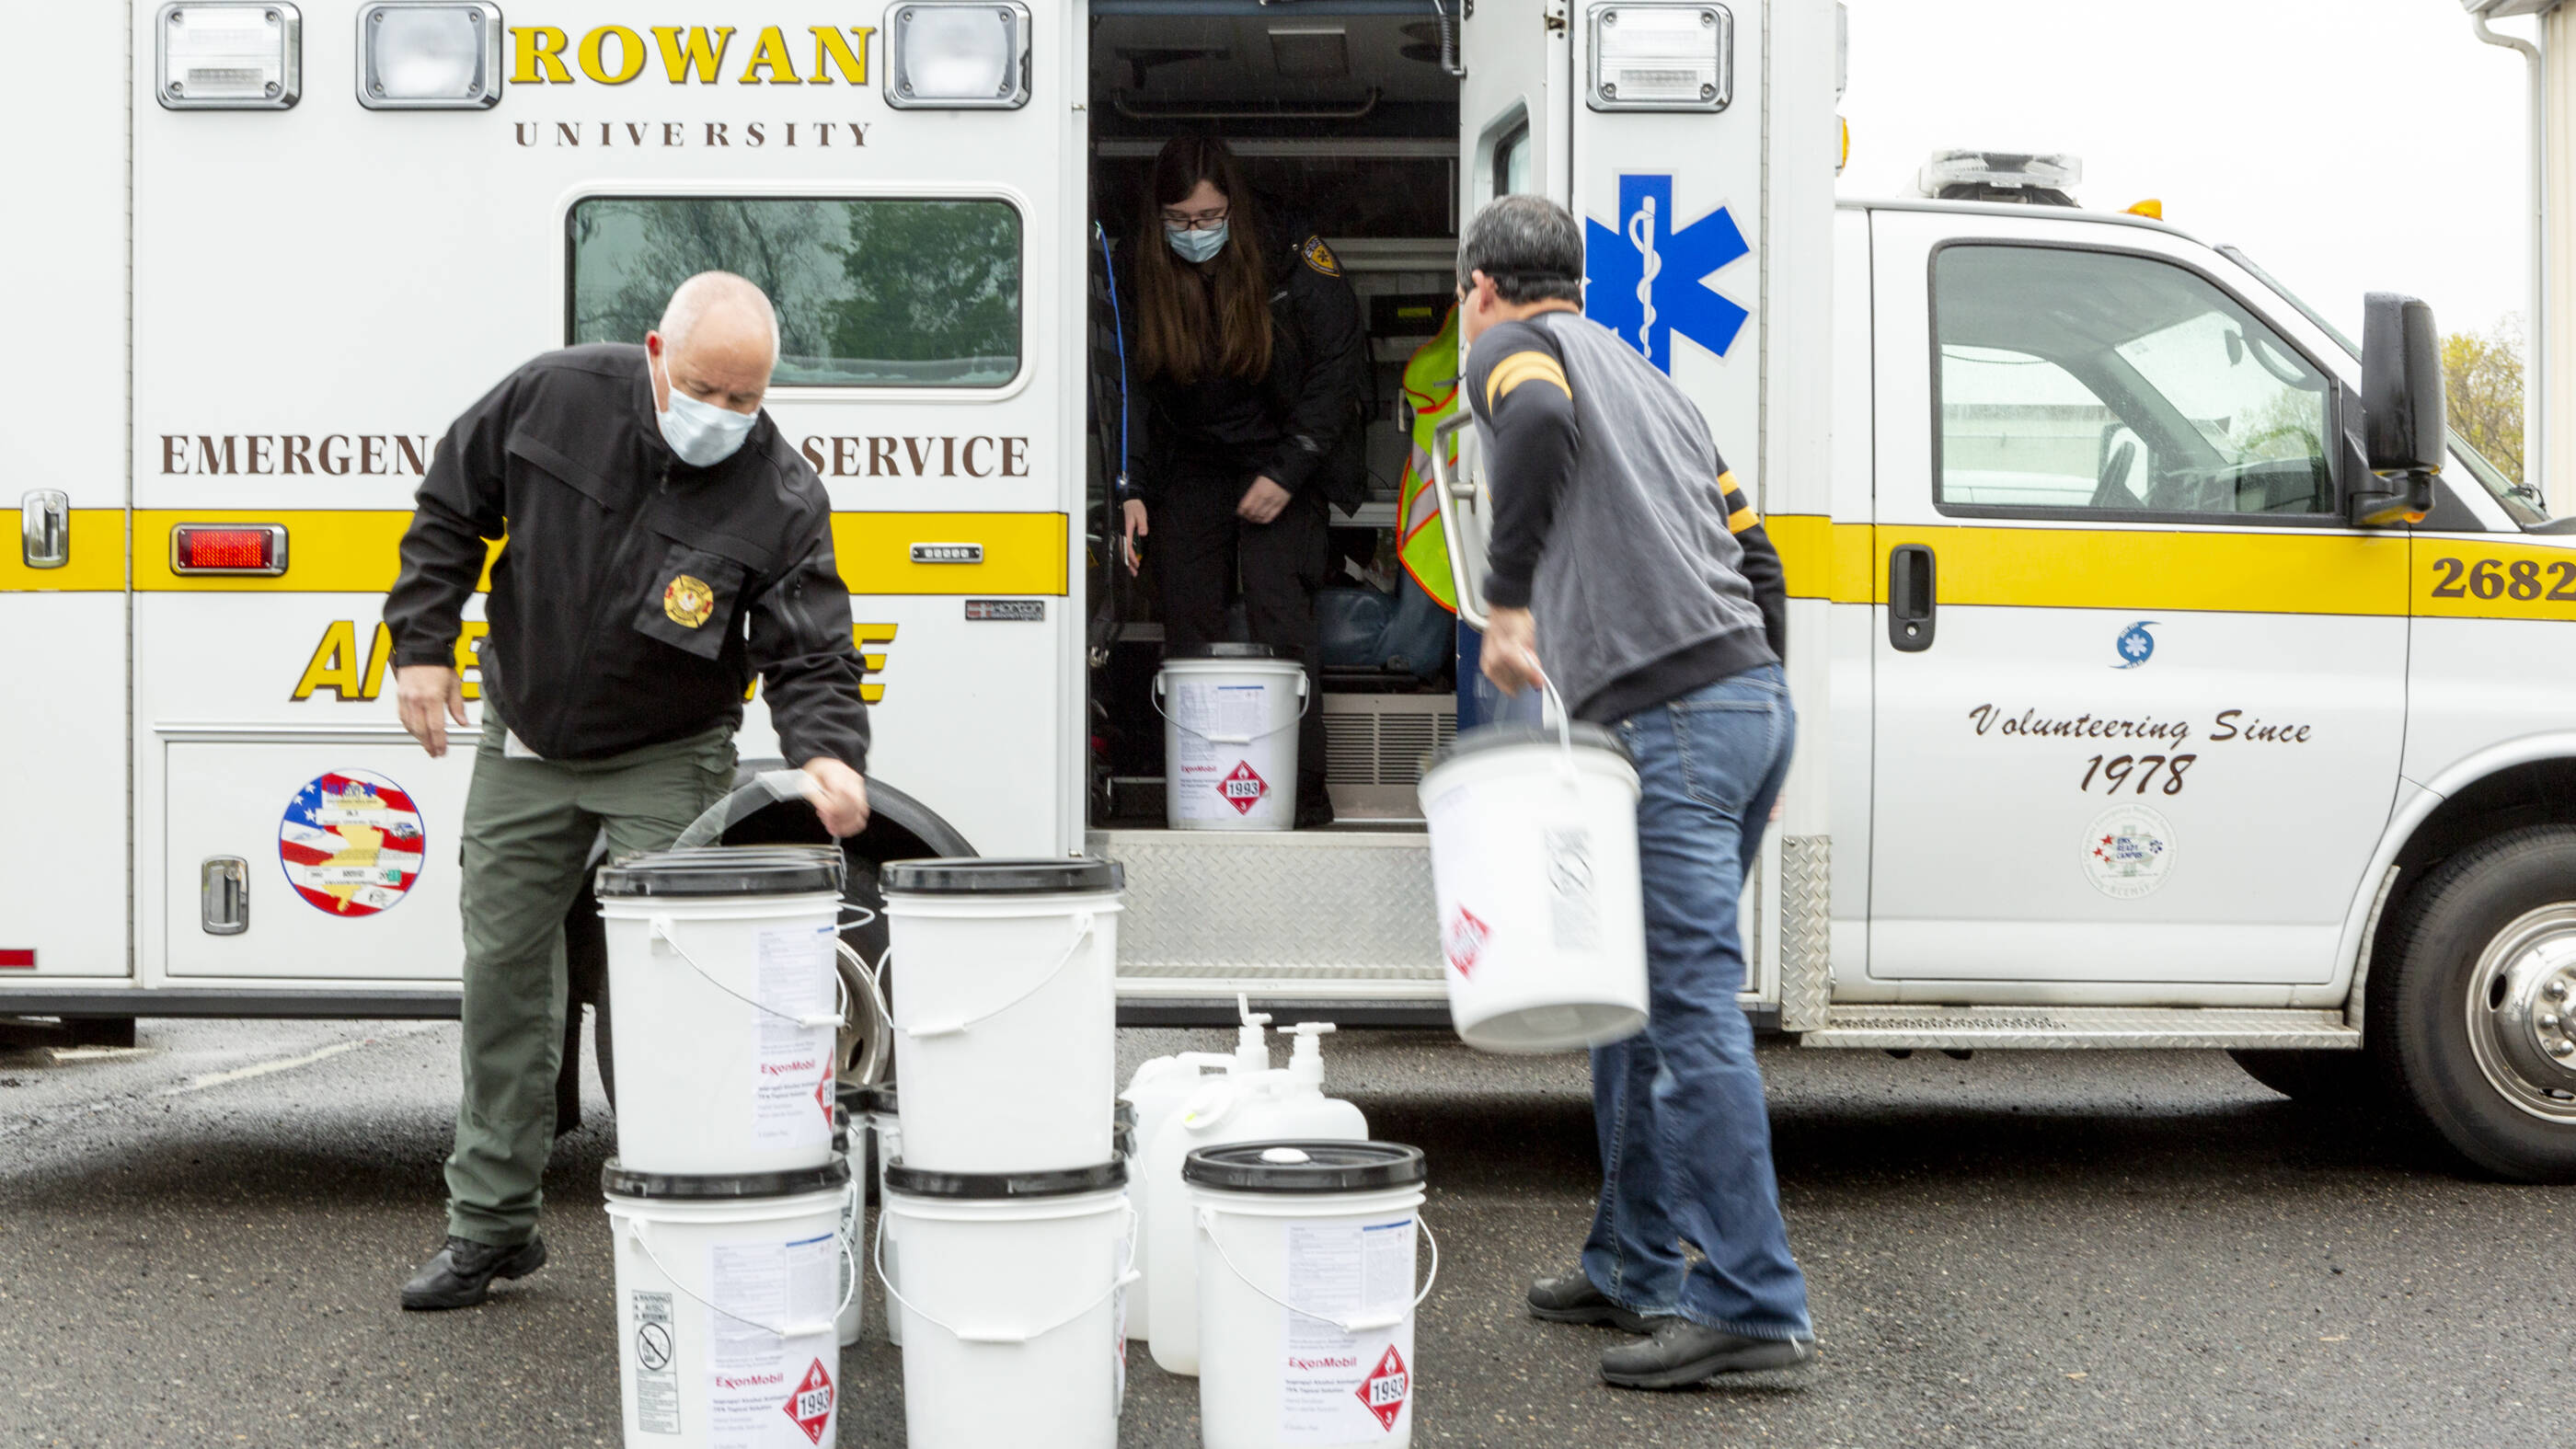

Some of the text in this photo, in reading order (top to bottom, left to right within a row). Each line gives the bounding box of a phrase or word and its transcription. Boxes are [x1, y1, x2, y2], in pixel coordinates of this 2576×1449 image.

[509, 26, 877, 86] ROWAN
[515, 122, 872, 146] UNIVERSITY
[802, 435, 1029, 477] SERVICE
[2432, 558, 2576, 601] 2682
[1969, 704, 2311, 750] Volunteering Since
[2081, 753, 2197, 796] 1978
[1228, 782, 1259, 796] 1993
[761, 1058, 816, 1076] ExxonMobil
[1289, 1356, 1357, 1371] ExxonMobil
[715, 1372, 784, 1390] ExxonMobil
[1372, 1376, 1404, 1402] 1993
[799, 1388, 830, 1416] 1993
[1385, 1410, 1394, 1424] 3
[811, 1423, 821, 1437] 3
